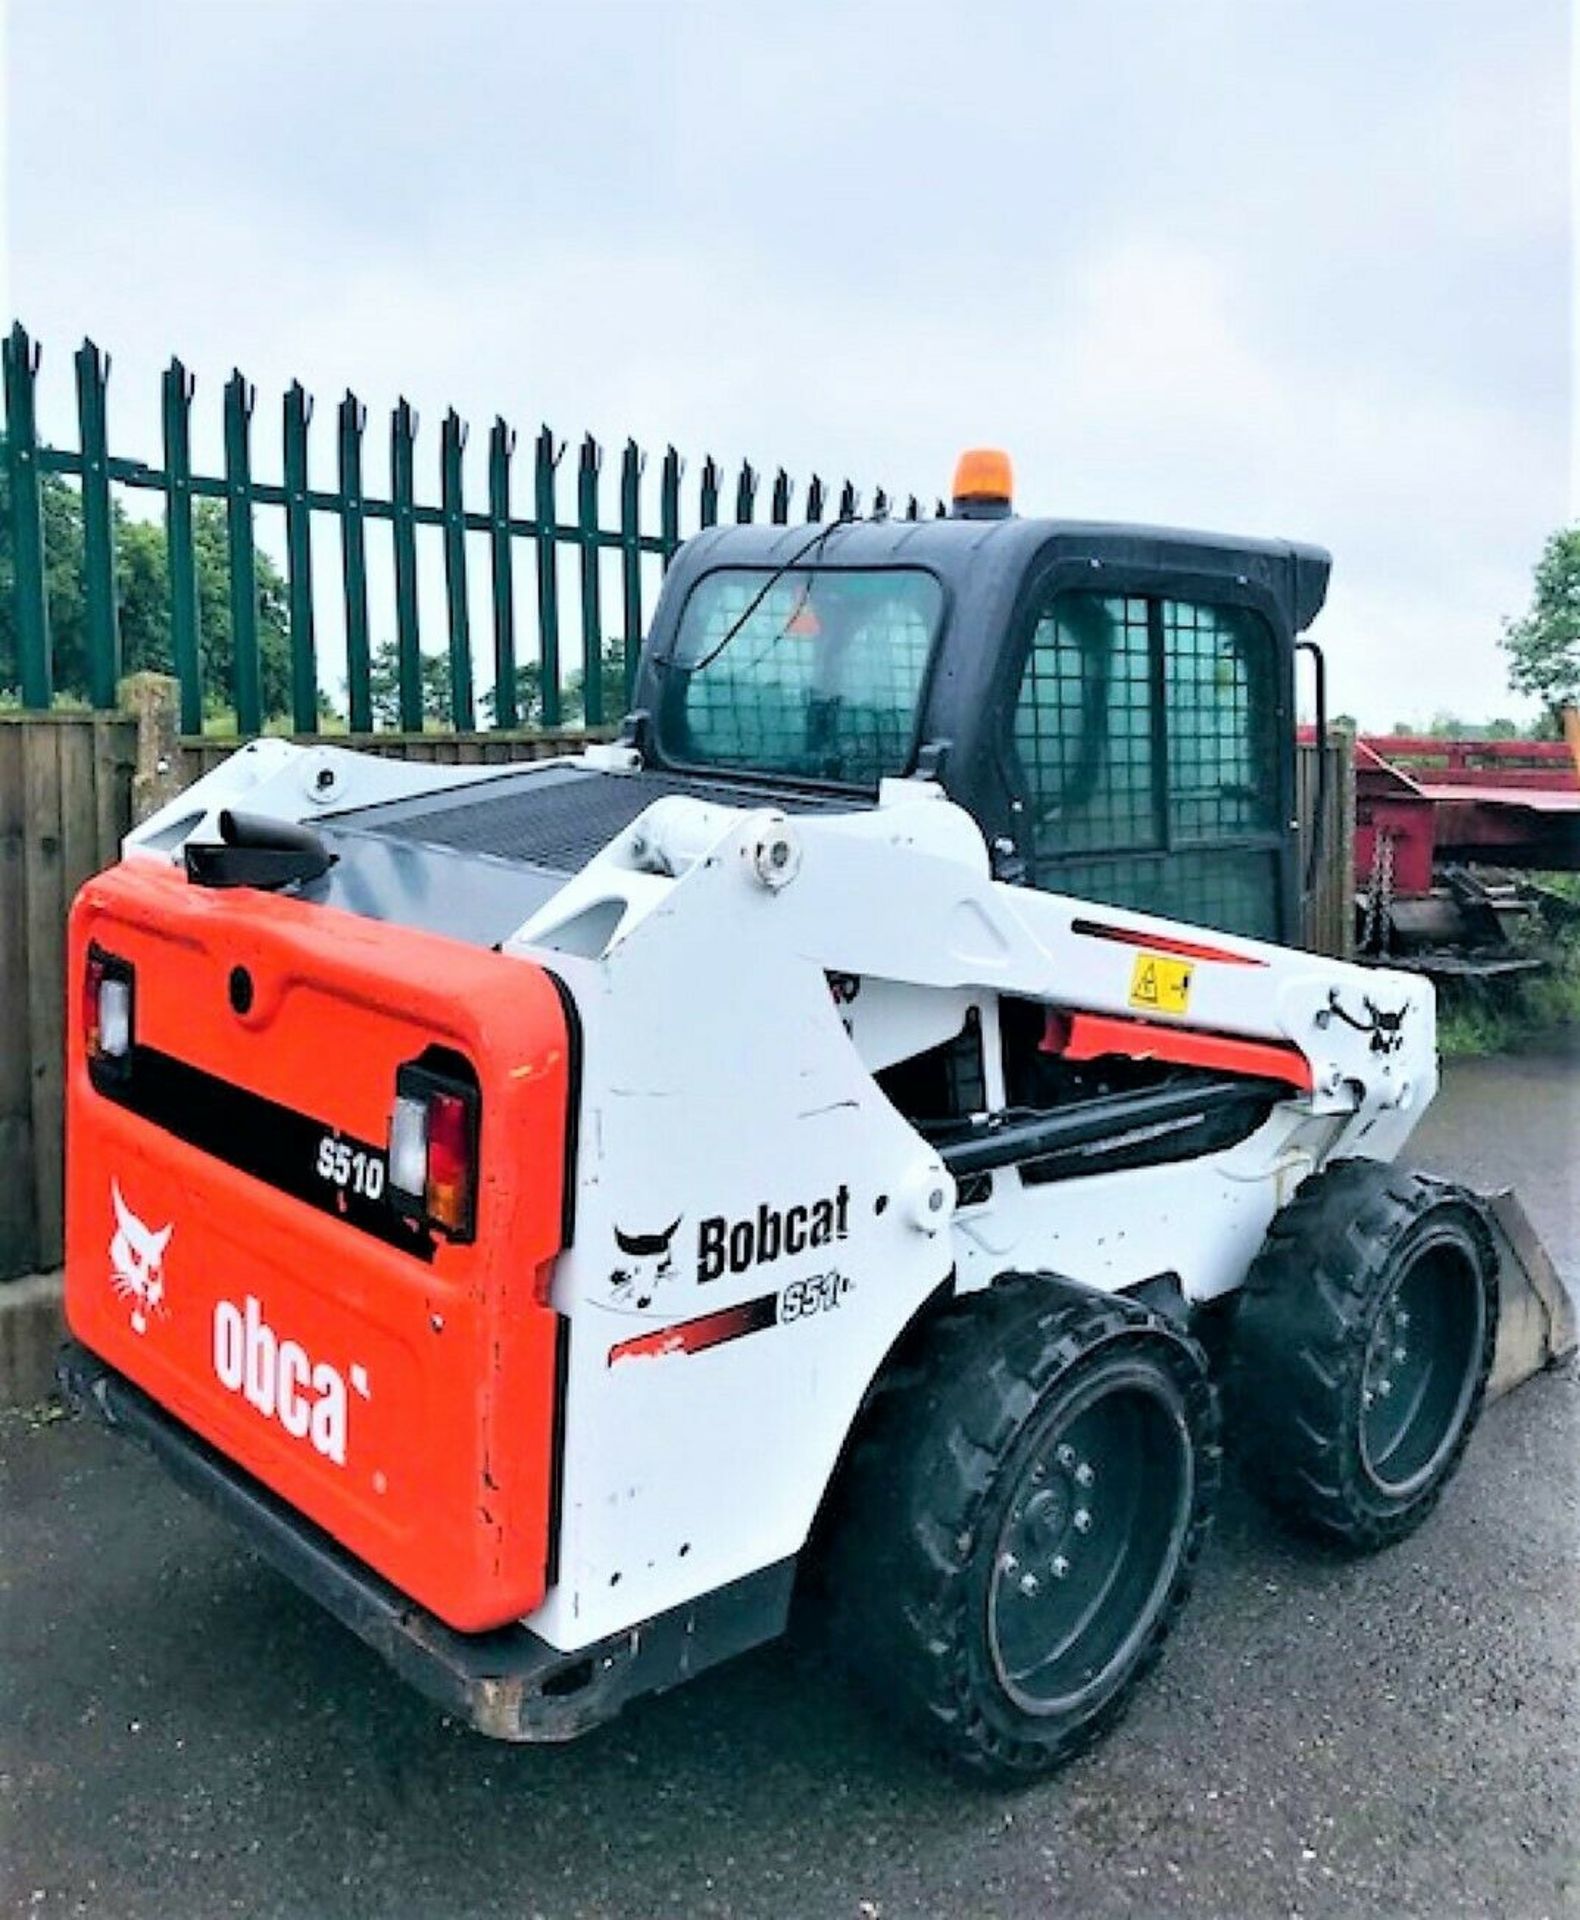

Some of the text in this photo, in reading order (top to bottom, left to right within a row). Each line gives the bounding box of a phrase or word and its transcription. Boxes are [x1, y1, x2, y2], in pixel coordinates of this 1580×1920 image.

[317, 1136, 384, 1200] S510
[697, 1184, 849, 1285] Bobcat
[780, 1268, 850, 1324] S51
[213, 1294, 370, 1466] obca
